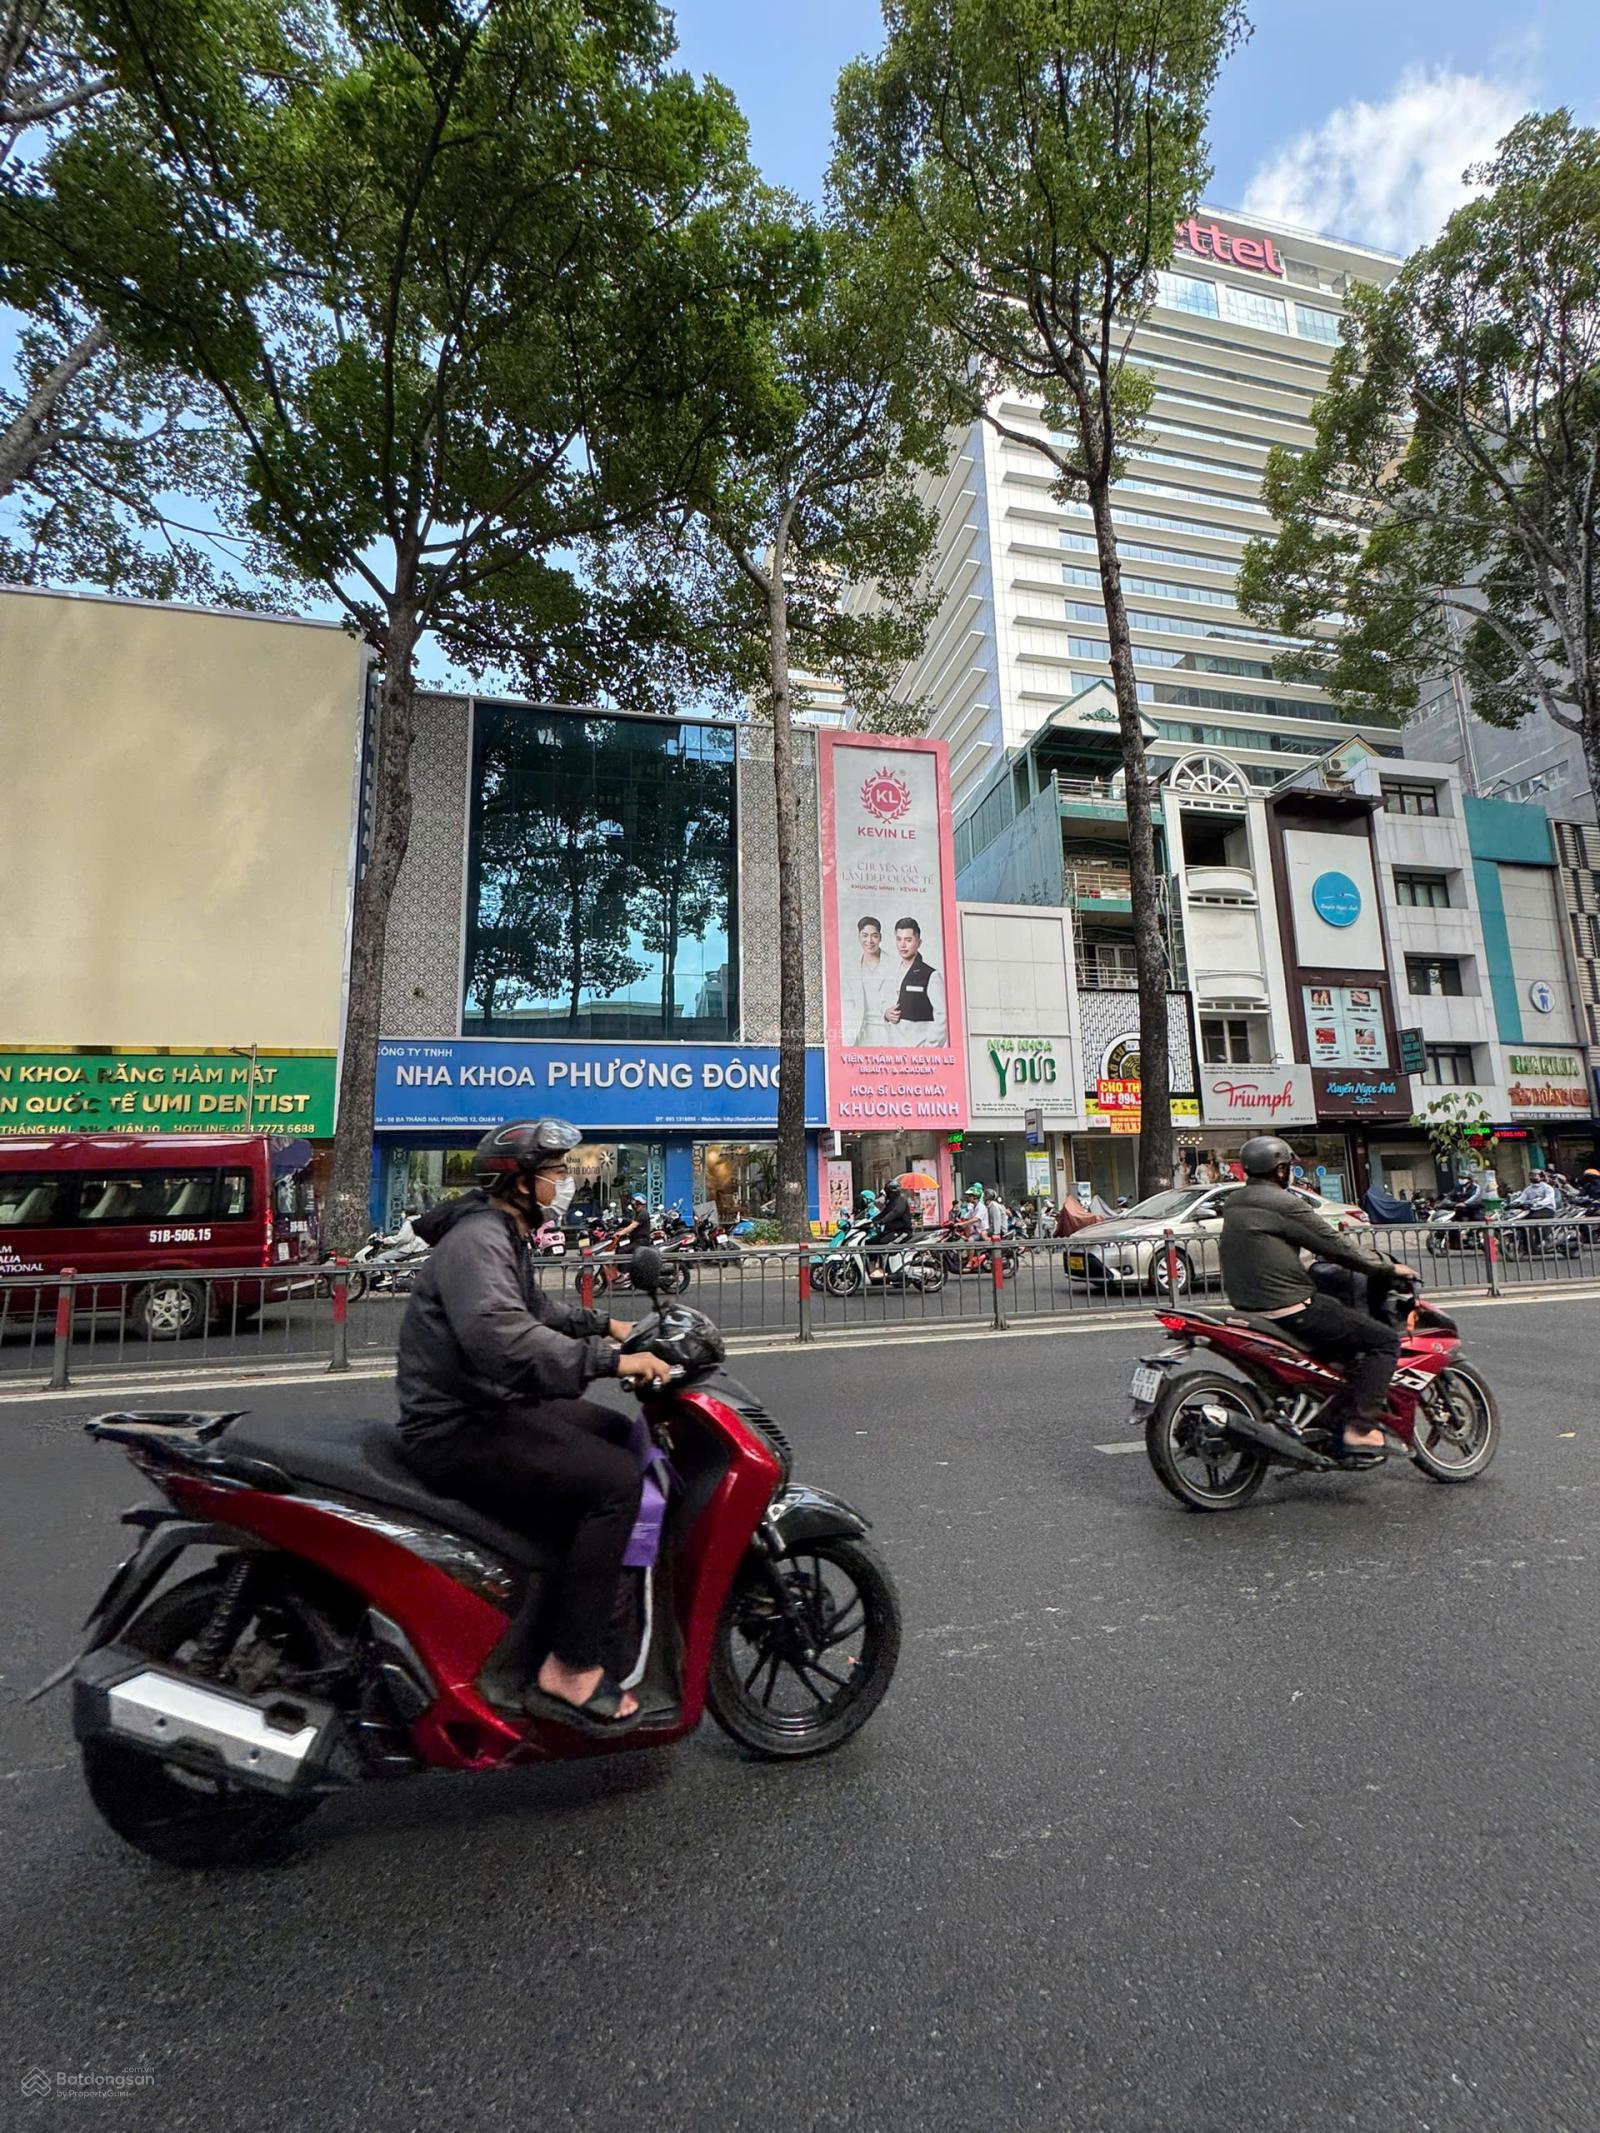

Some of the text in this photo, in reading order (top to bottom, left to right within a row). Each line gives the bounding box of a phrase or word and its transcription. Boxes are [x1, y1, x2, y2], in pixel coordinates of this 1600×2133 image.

[876, 790, 899, 804] KL
[857, 826, 917, 840] KEVIN LE
[408, 1048, 421, 1057] TY
[424, 1048, 453, 1057] TNHH
[20, 1066, 89, 1083] KHOA
[98, 1063, 165, 1083] RĂNG
[172, 1064, 223, 1083] HÀM
[231, 1064, 277, 1088] MẶT
[396, 1065, 453, 1087] NHA
[459, 1065, 536, 1087] KHOA
[548, 1058, 693, 1088] PHƯƠNG
[1100, 1081, 1142, 1093] CHO TH
[1355, 1083, 1377, 1097] Ngọc
[1379, 1082, 1397, 1094] Anh
[26, 1091, 100, 1114] QUỐC
[110, 1091, 140, 1113] TẾ
[143, 1094, 192, 1113] UMI
[199, 1094, 310, 1113] DENTIST
[1101, 1093, 1116, 1105] LH:
[1212, 1081, 1294, 1117] Triumph
[1353, 1095, 1373, 1105] Spa
[917, 1101, 961, 1117] MINH
[1, 1122, 45, 1134] THÁNG
[173, 1124, 229, 1133] HOTLINE:
[257, 1124, 284, 1133] 7773
[287, 1124, 315, 1133] 6688
[149, 1227, 212, 1243] 51B-506.15
